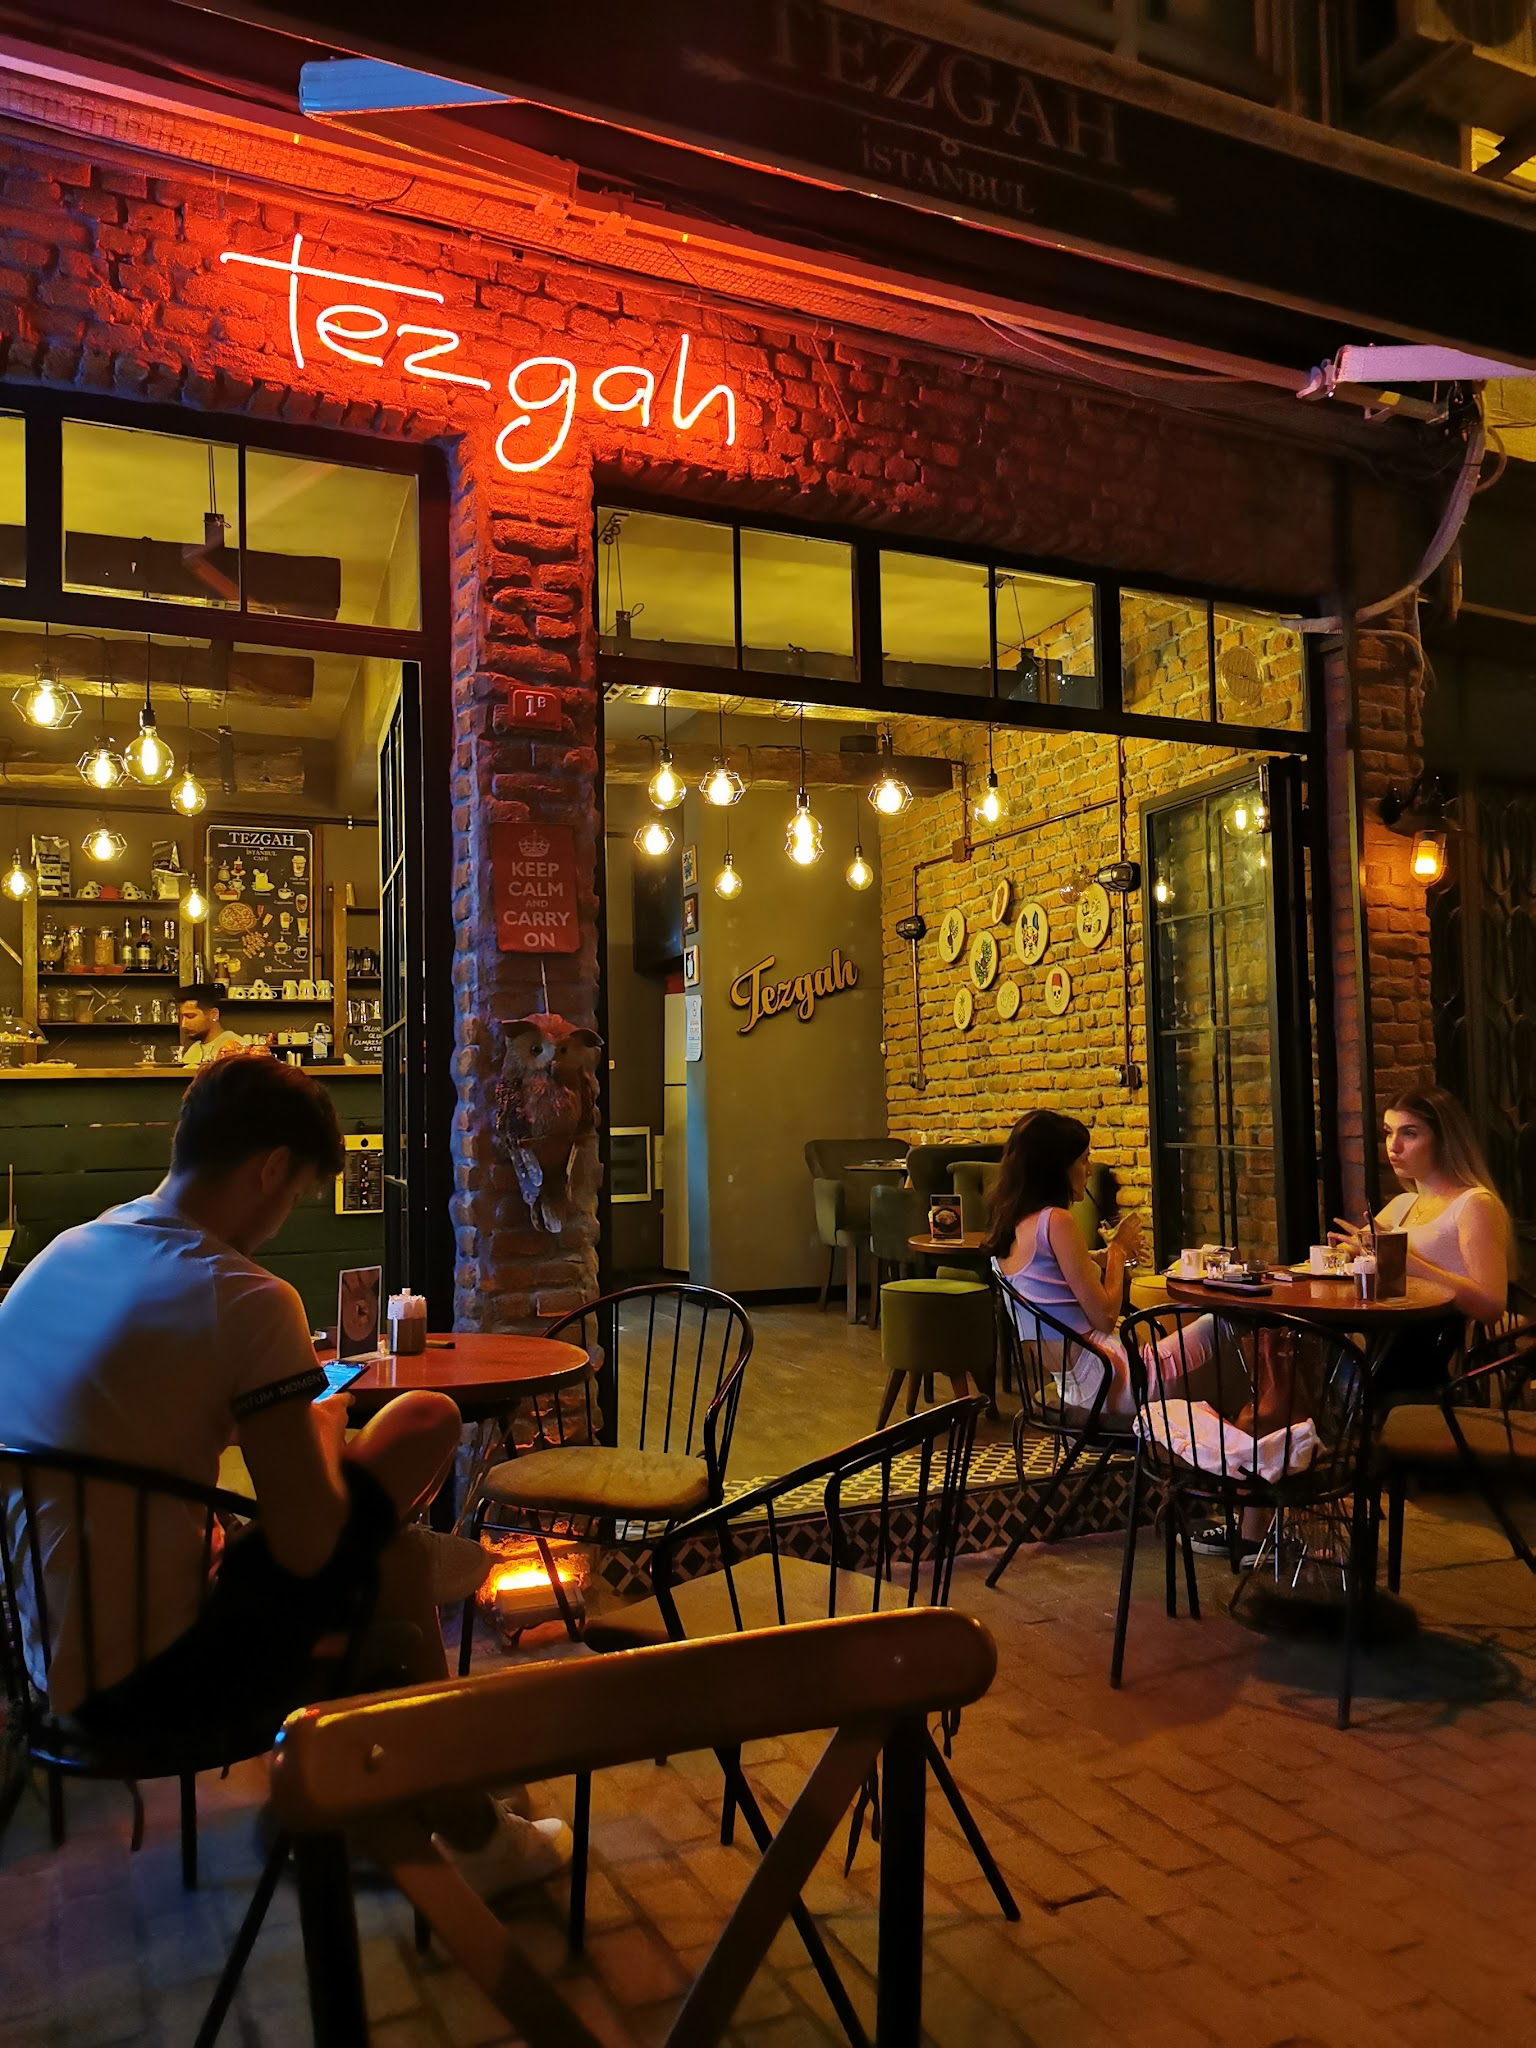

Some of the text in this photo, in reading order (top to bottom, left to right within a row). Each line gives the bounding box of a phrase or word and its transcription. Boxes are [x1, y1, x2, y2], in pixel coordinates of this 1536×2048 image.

[766, 0, 1122, 167] TEZGAH
[860, 123, 1037, 216] İSTANBUL
[228, 832, 295, 847] TEZGAH
[511, 861, 560, 878] KEEP
[508, 881, 564, 897] CALM
[525, 899, 549, 908] AND
[503, 910, 571, 928] CARRY
[523, 932, 556, 948] ON
[730, 948, 858, 1033] Tezgah
